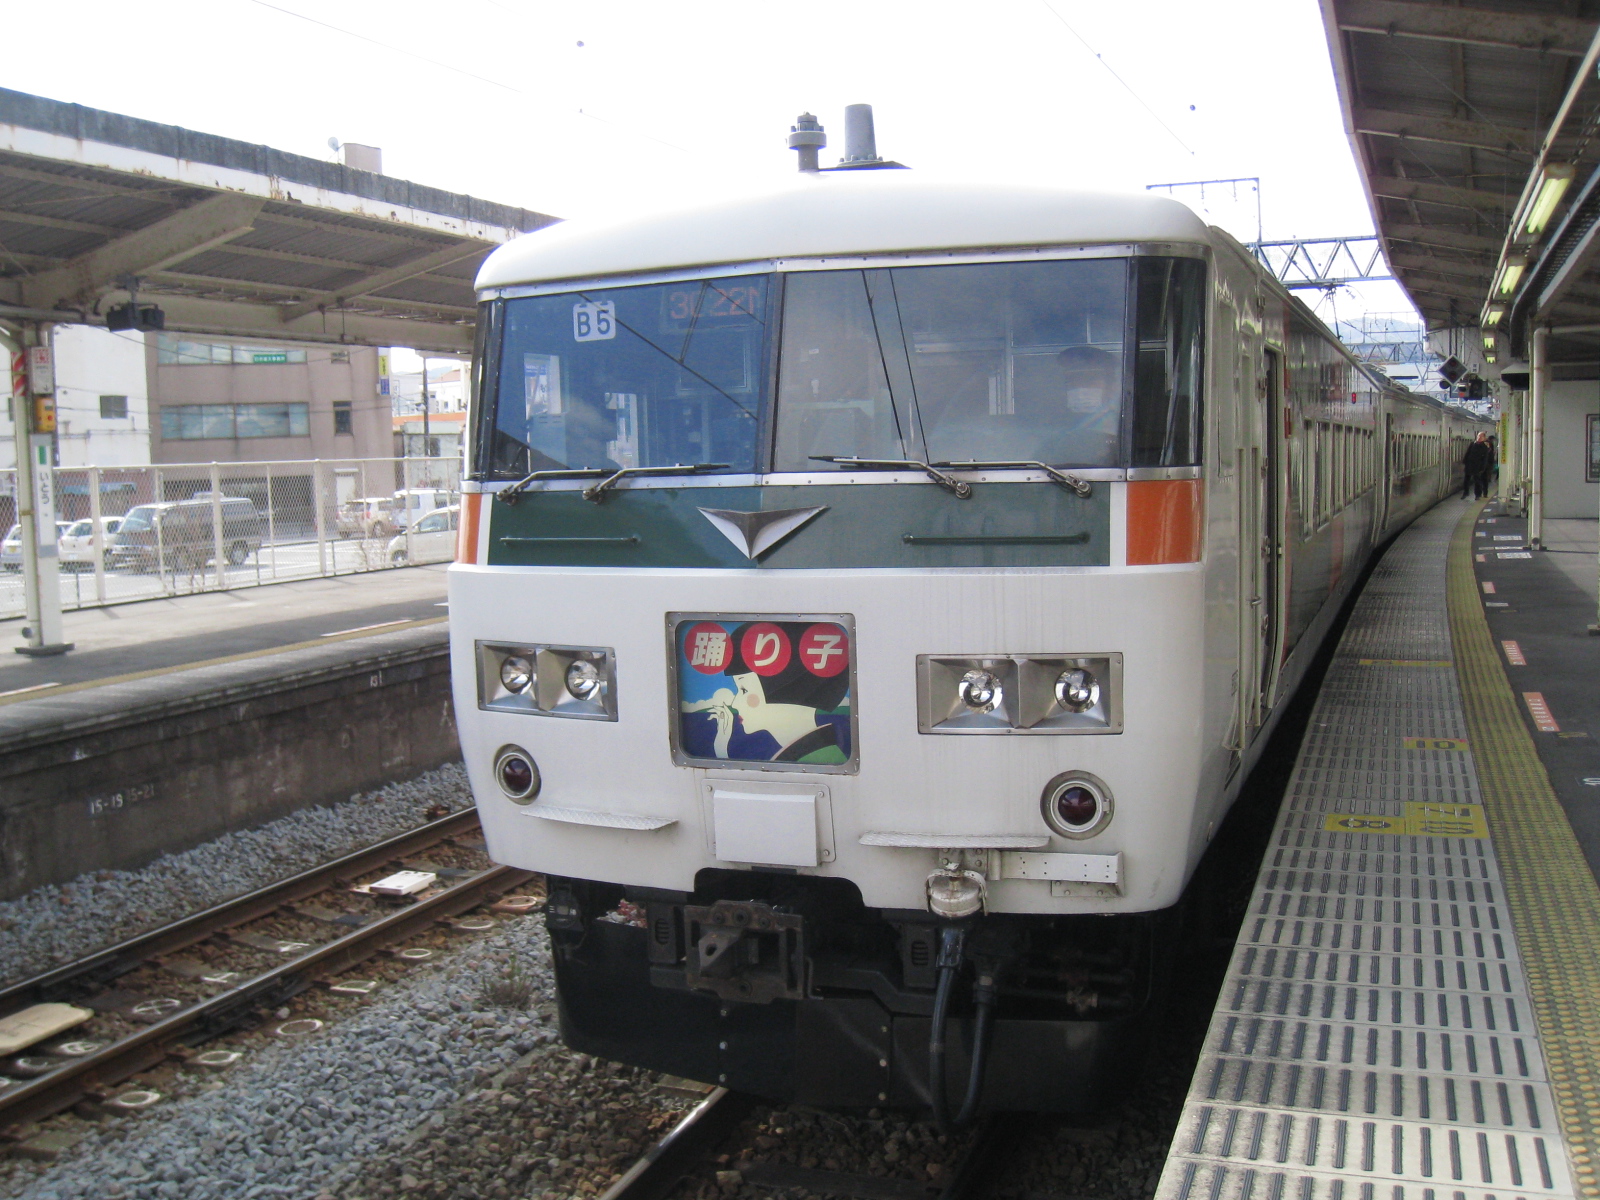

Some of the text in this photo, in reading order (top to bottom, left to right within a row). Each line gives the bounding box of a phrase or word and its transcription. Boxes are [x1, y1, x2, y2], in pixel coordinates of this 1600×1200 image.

[39, 472, 50, 505] いとう
[691, 632, 843, 671] 踊り子
